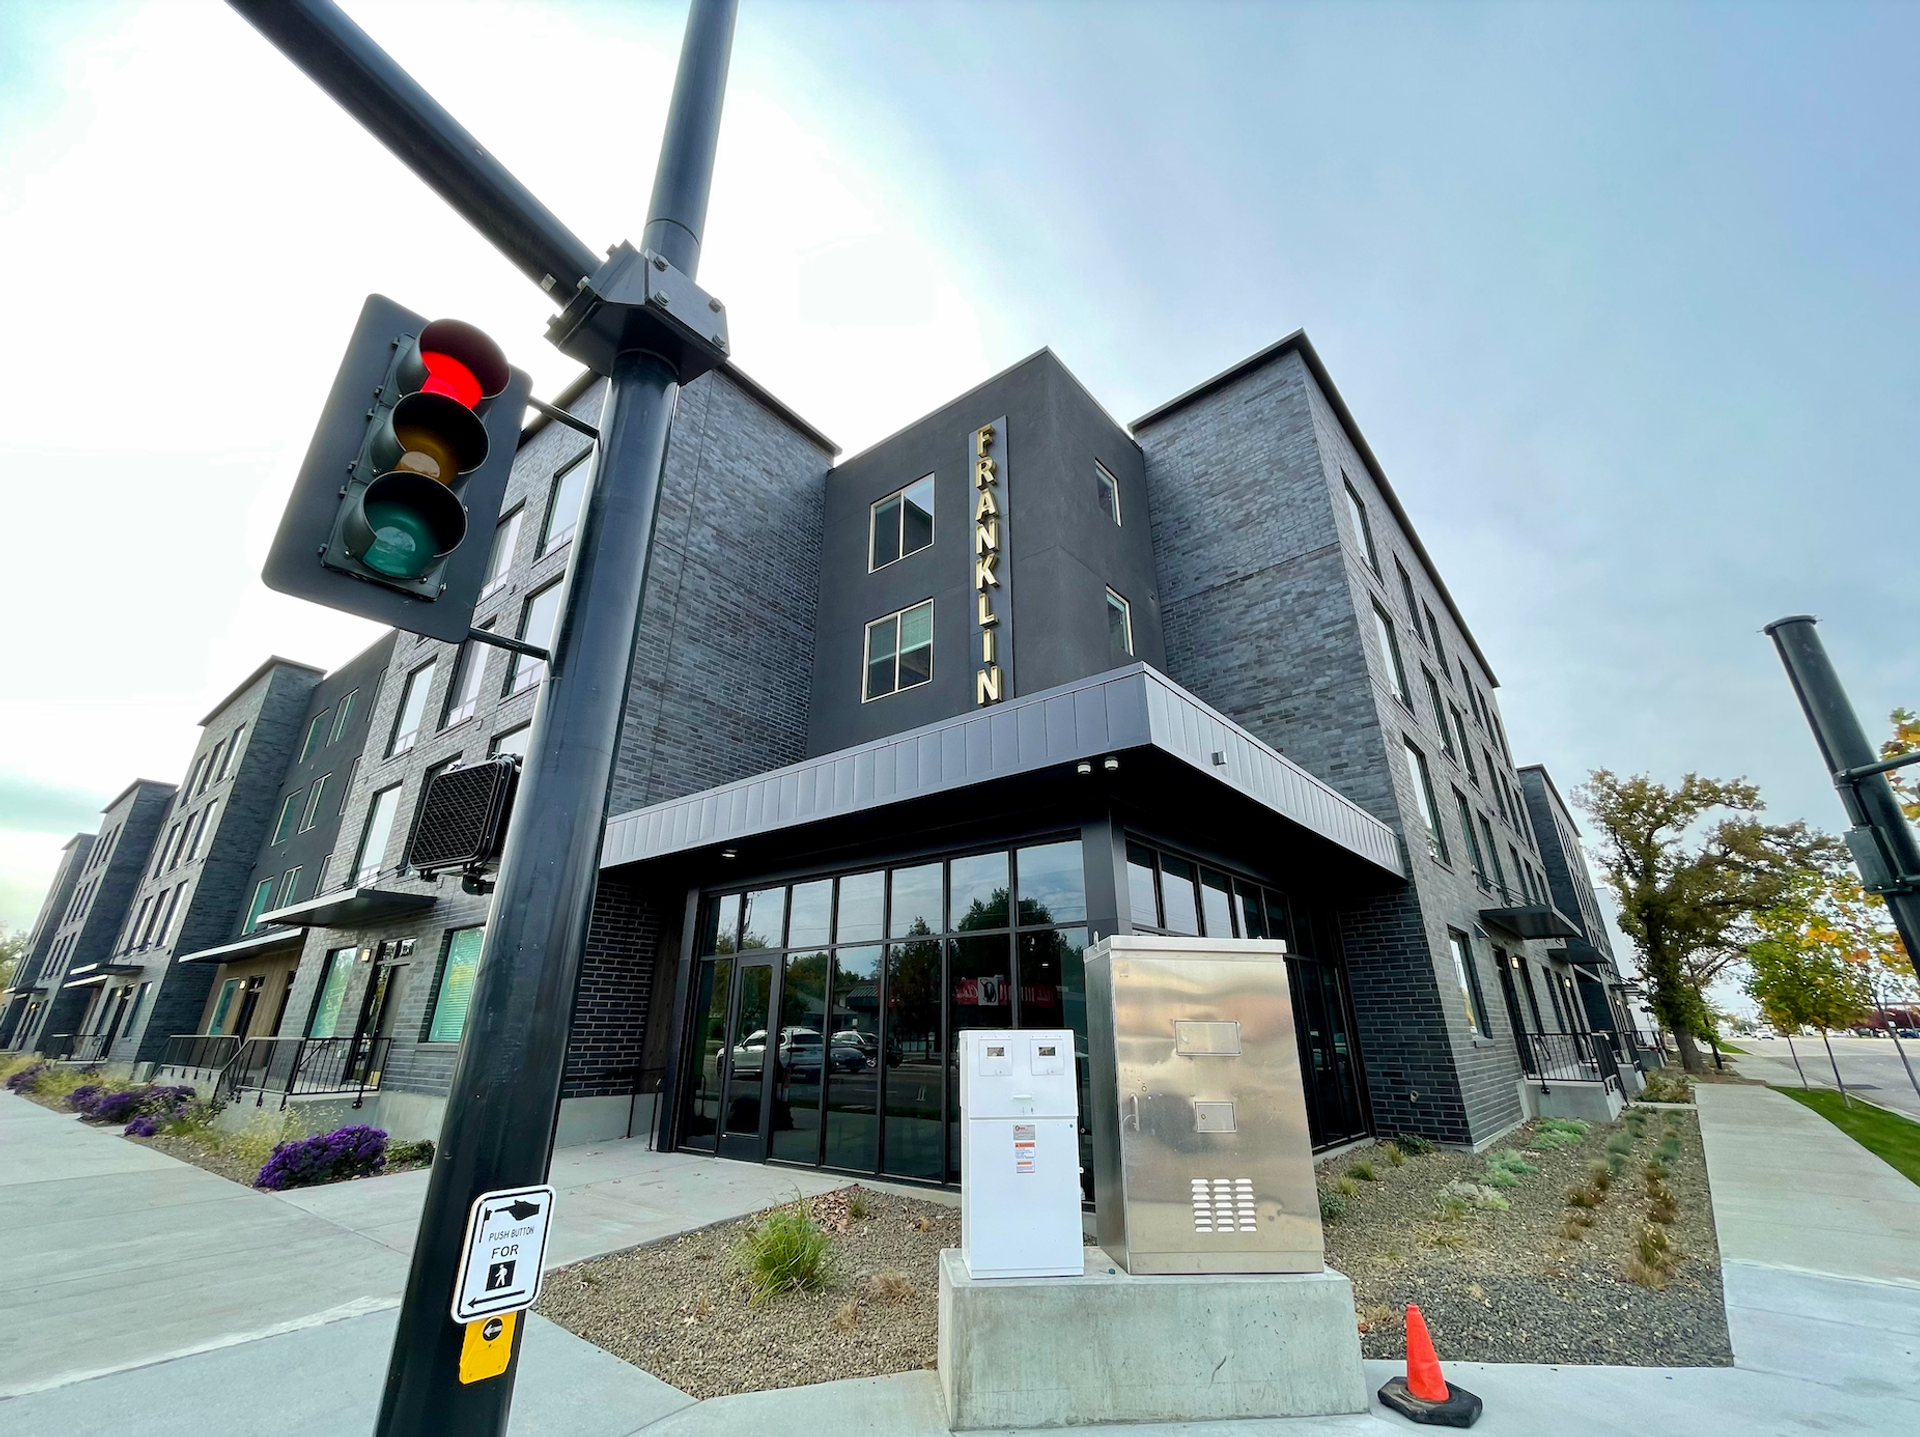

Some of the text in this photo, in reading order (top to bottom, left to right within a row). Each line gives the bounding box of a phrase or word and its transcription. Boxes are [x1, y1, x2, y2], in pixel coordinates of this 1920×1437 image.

[975, 424, 1002, 707] FRANKLIN
[488, 1226, 535, 1242] PUSH BUTTON
[491, 1244, 519, 1259] FOR
